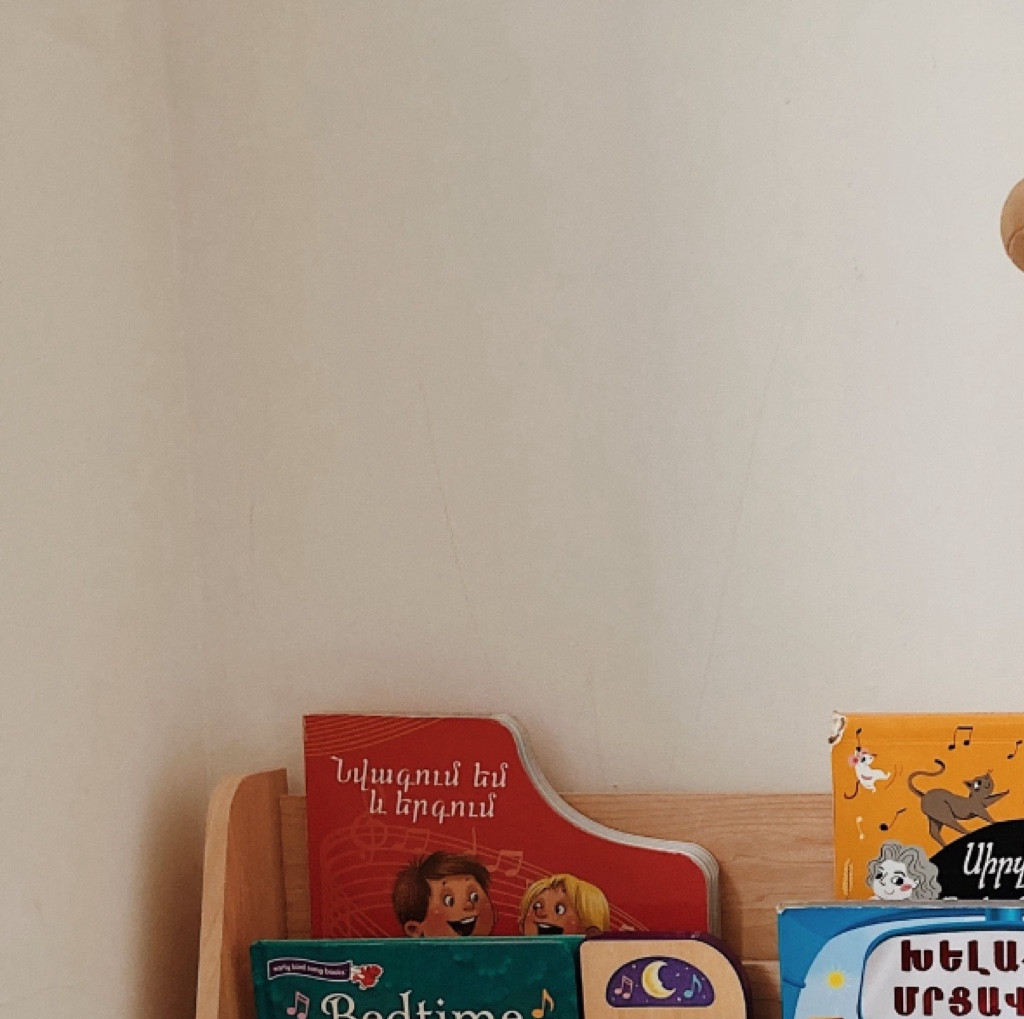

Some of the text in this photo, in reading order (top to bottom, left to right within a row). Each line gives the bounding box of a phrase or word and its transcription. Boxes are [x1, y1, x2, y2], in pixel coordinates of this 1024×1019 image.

[330, 756, 509, 792] Նվագում եմ
[396, 789, 497, 824] երգում
